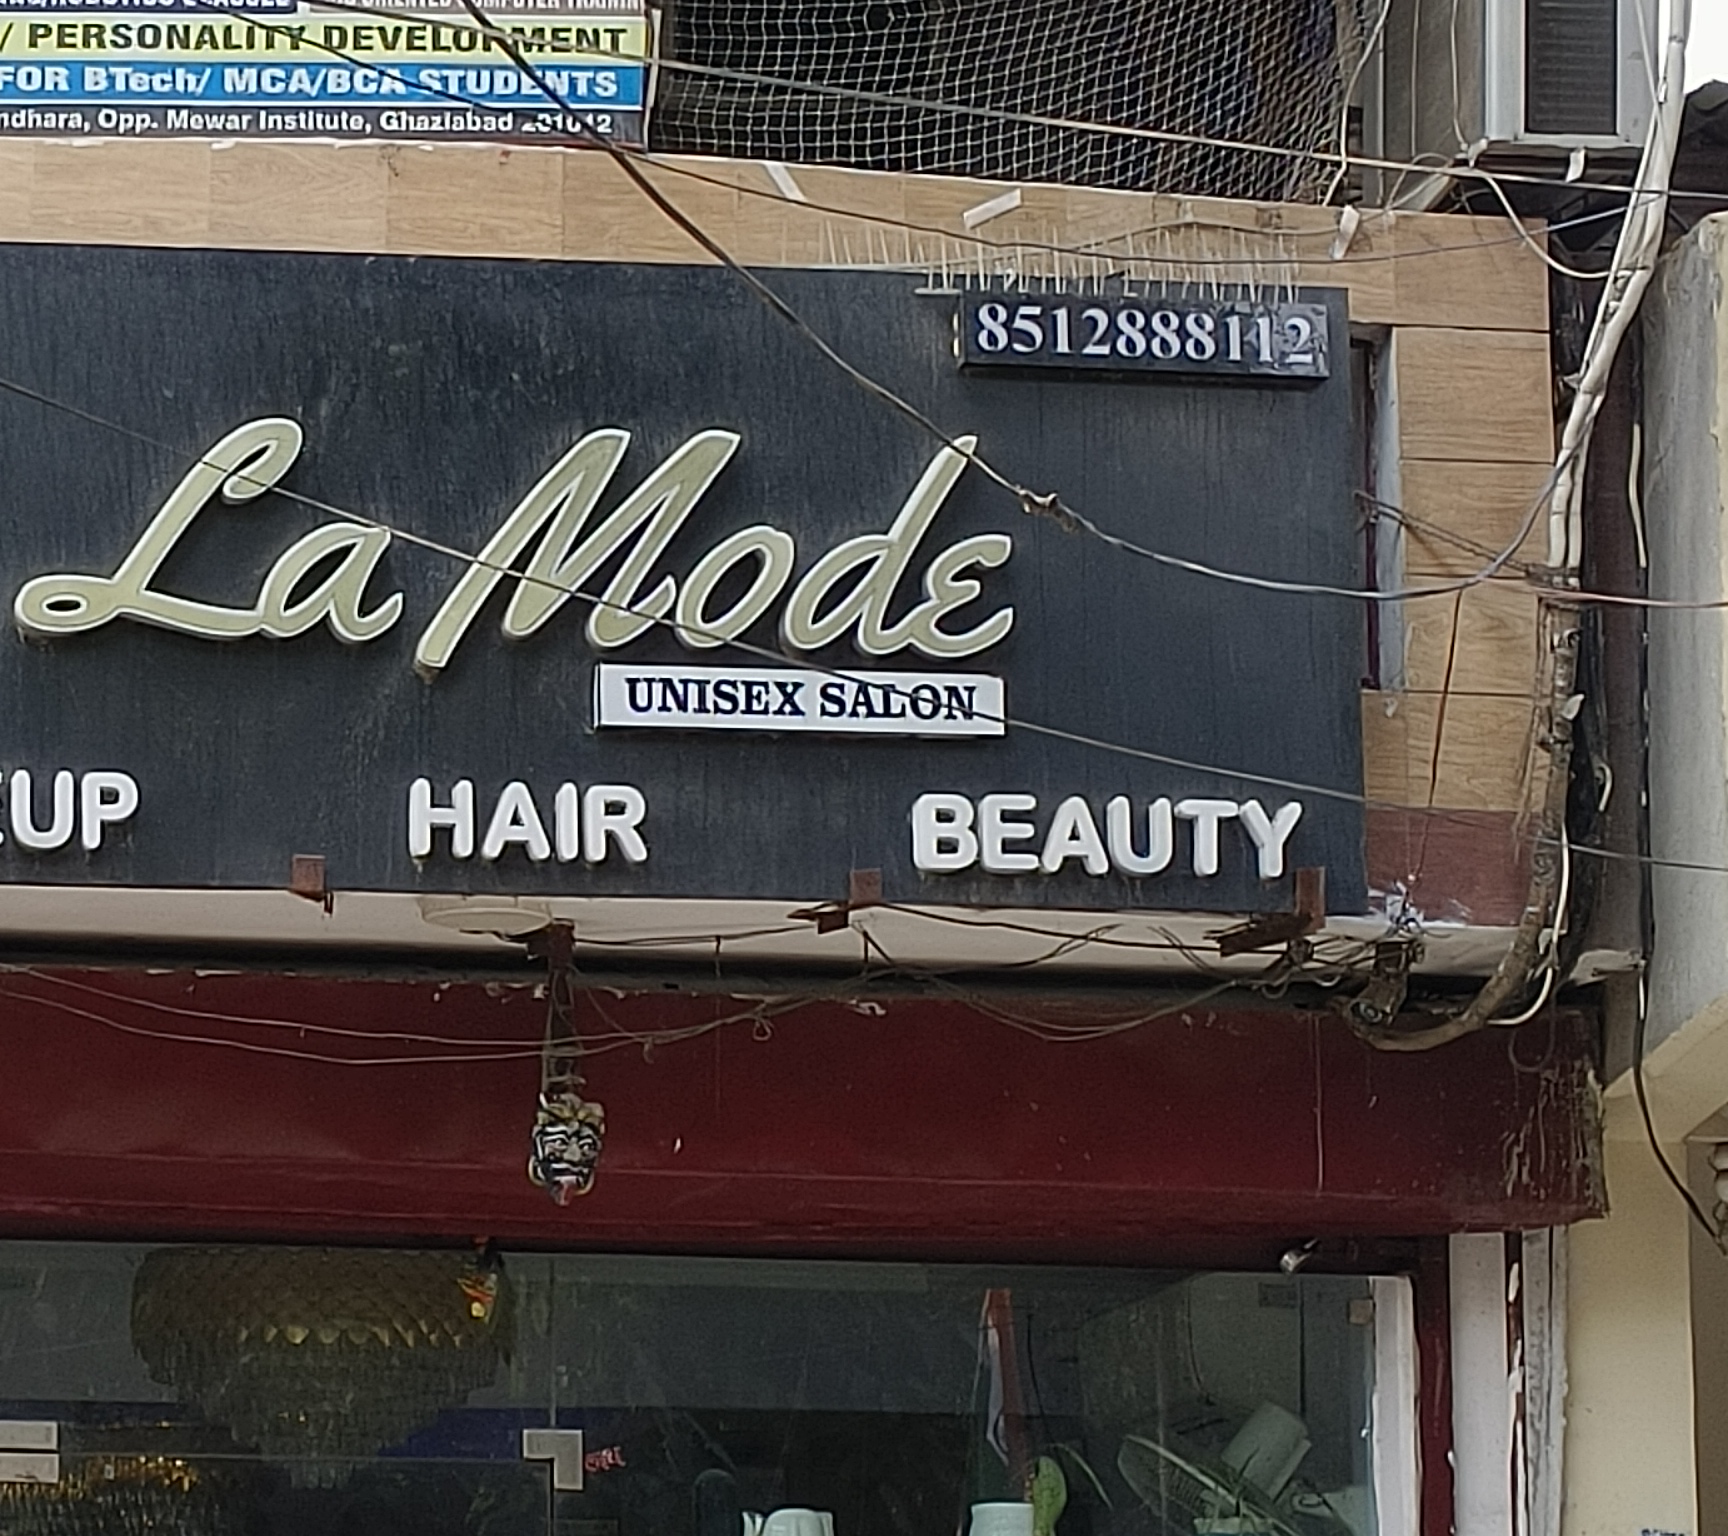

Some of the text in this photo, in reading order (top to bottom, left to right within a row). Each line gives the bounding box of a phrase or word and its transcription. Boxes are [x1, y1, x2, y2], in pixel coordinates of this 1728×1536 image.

[26, 22, 306, 53] PERSONALITY
[322, 24, 629, 55] DEVELOPMENT
[223, 65, 409, 98] MCA/BCA
[418, 68, 619, 97] STUDENTS
[96, 107, 160, 135] Opp.
[166, 109, 254, 132] Mewar
[258, 109, 373, 135] Institute,
[378, 110, 514, 133] Ghaziabad
[976, 301, 1315, 366] 8512888112
[13, 416, 1016, 674] La Mode
[624, 676, 978, 722] UNISEX SALON
[407, 776, 649, 863] HAIR
[910, 792, 1304, 881] BEAUTY
